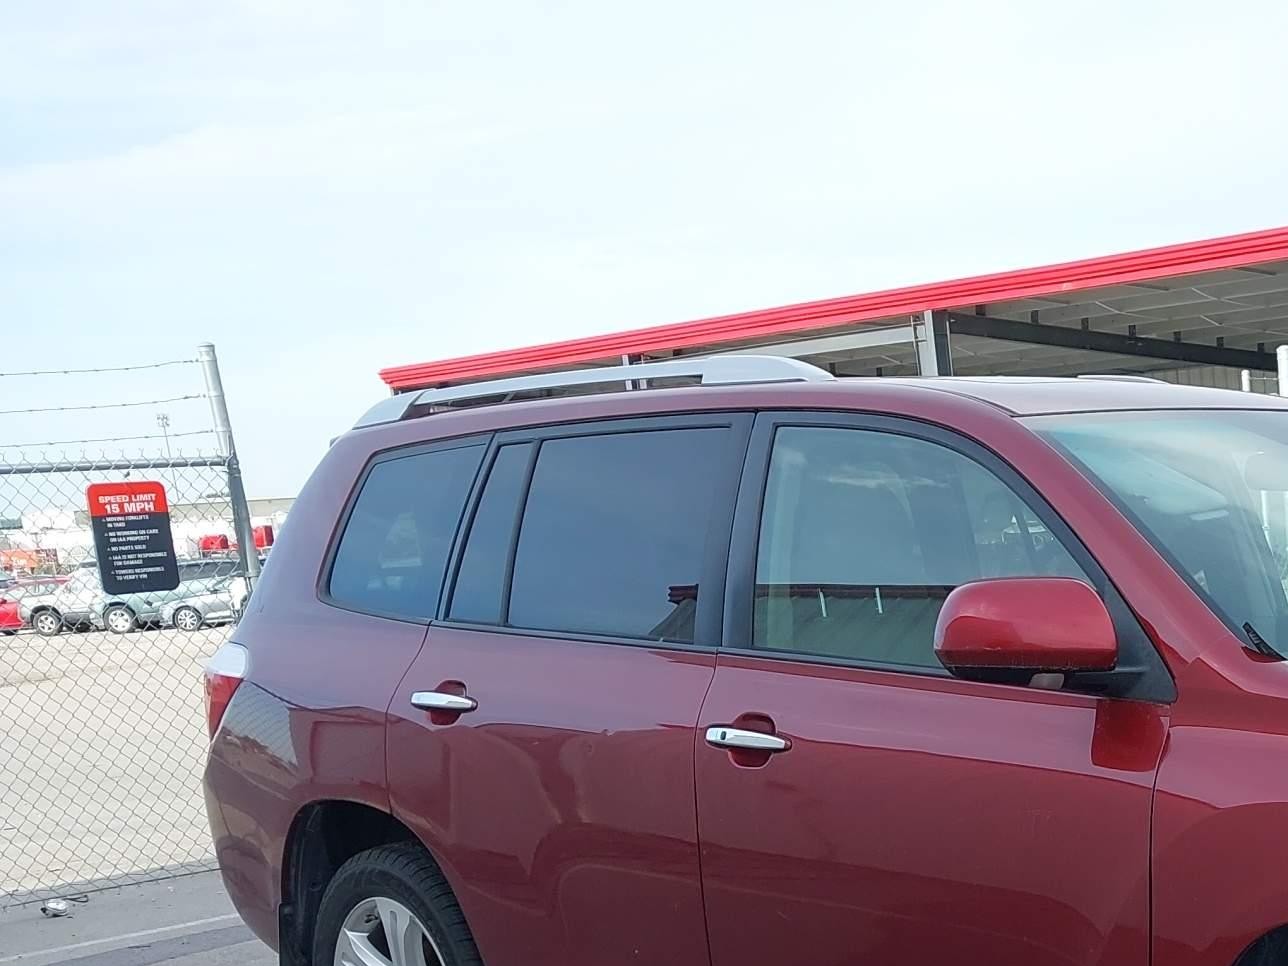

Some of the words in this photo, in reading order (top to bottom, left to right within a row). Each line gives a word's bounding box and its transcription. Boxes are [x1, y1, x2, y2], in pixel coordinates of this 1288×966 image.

[98, 495, 129, 503] SPEED
[104, 504, 120, 514] 15
[124, 502, 154, 513] MPH
